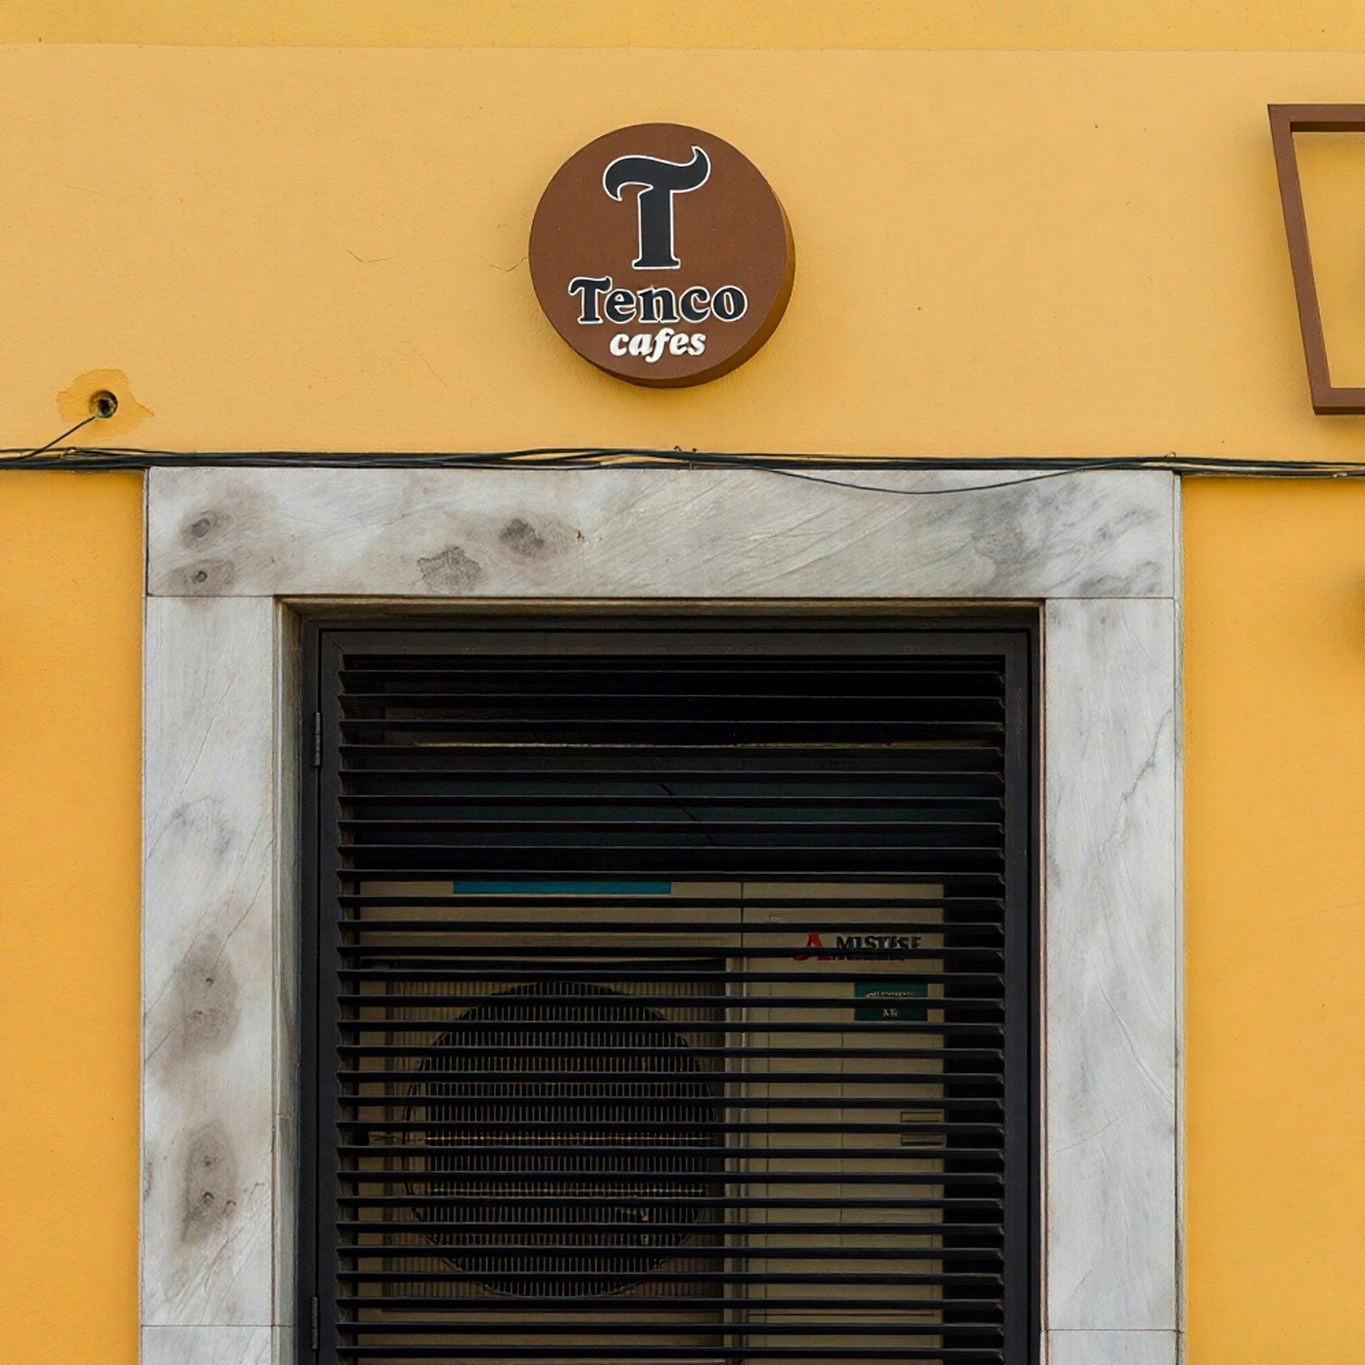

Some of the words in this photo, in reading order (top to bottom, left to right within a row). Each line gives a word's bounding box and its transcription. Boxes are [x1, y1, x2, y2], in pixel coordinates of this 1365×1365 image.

[603, 145, 711, 270] T
[568, 276, 748, 324] Tenco
[609, 327, 706, 363] cafes
